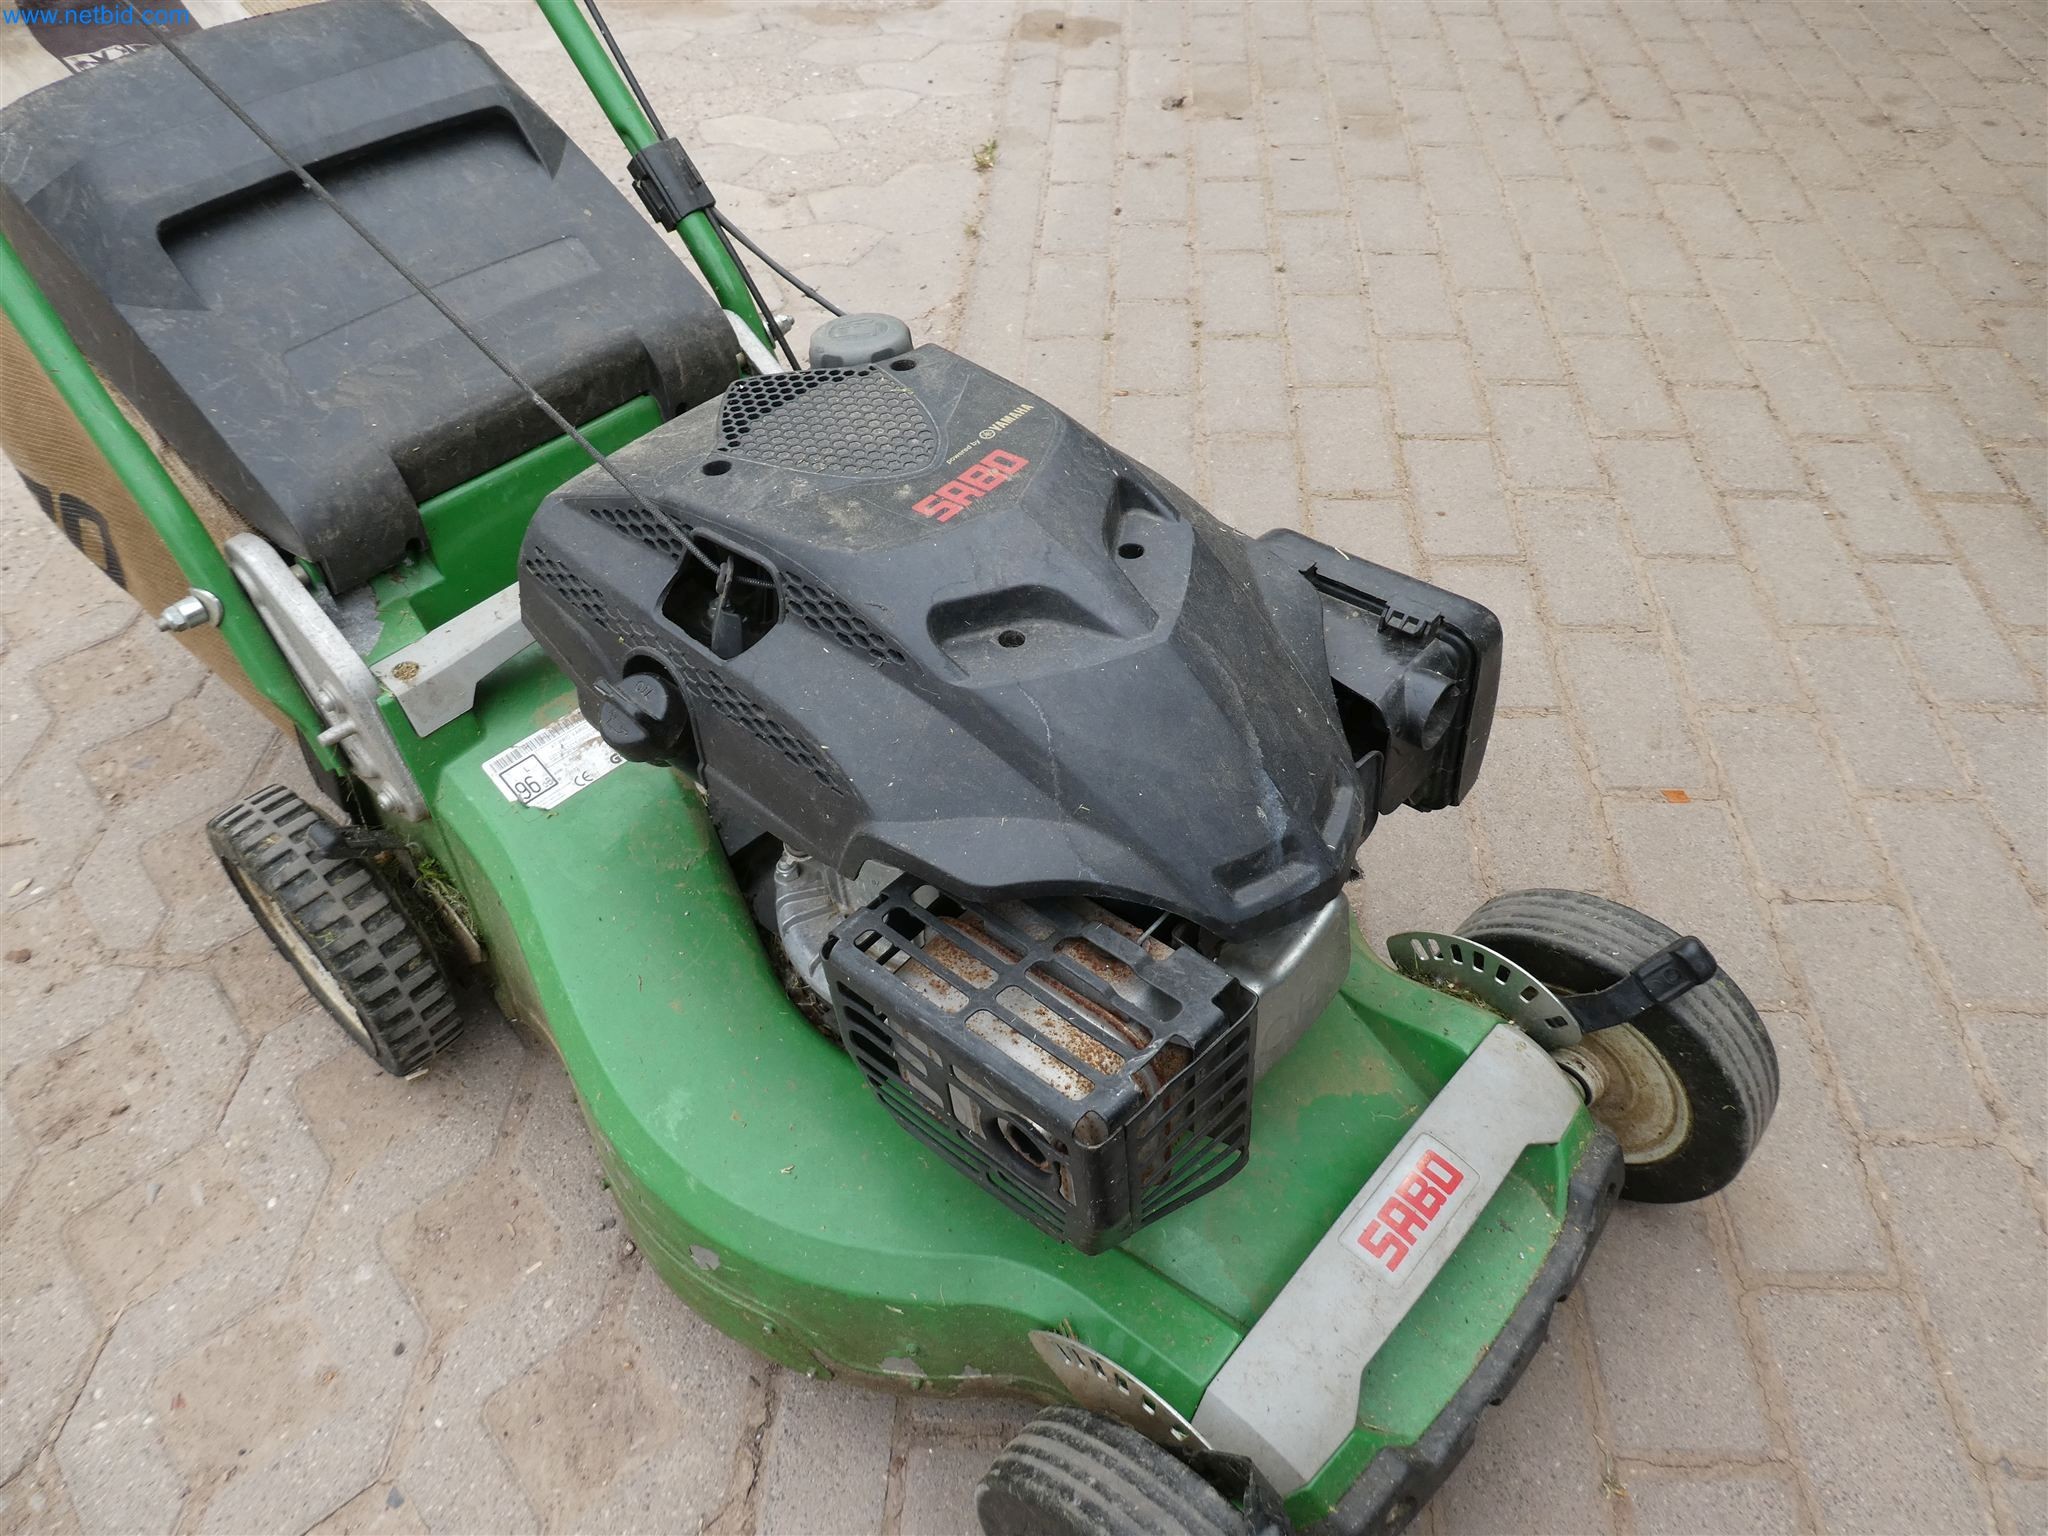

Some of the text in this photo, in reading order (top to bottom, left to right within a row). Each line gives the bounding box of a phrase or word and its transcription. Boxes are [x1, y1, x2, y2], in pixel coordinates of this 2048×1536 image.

[946, 403, 1034, 465] powered by YAMAHA
[912, 449, 1029, 523] SABO
[514, 776, 541, 799] 96
[1357, 1149, 1464, 1273] SABO
